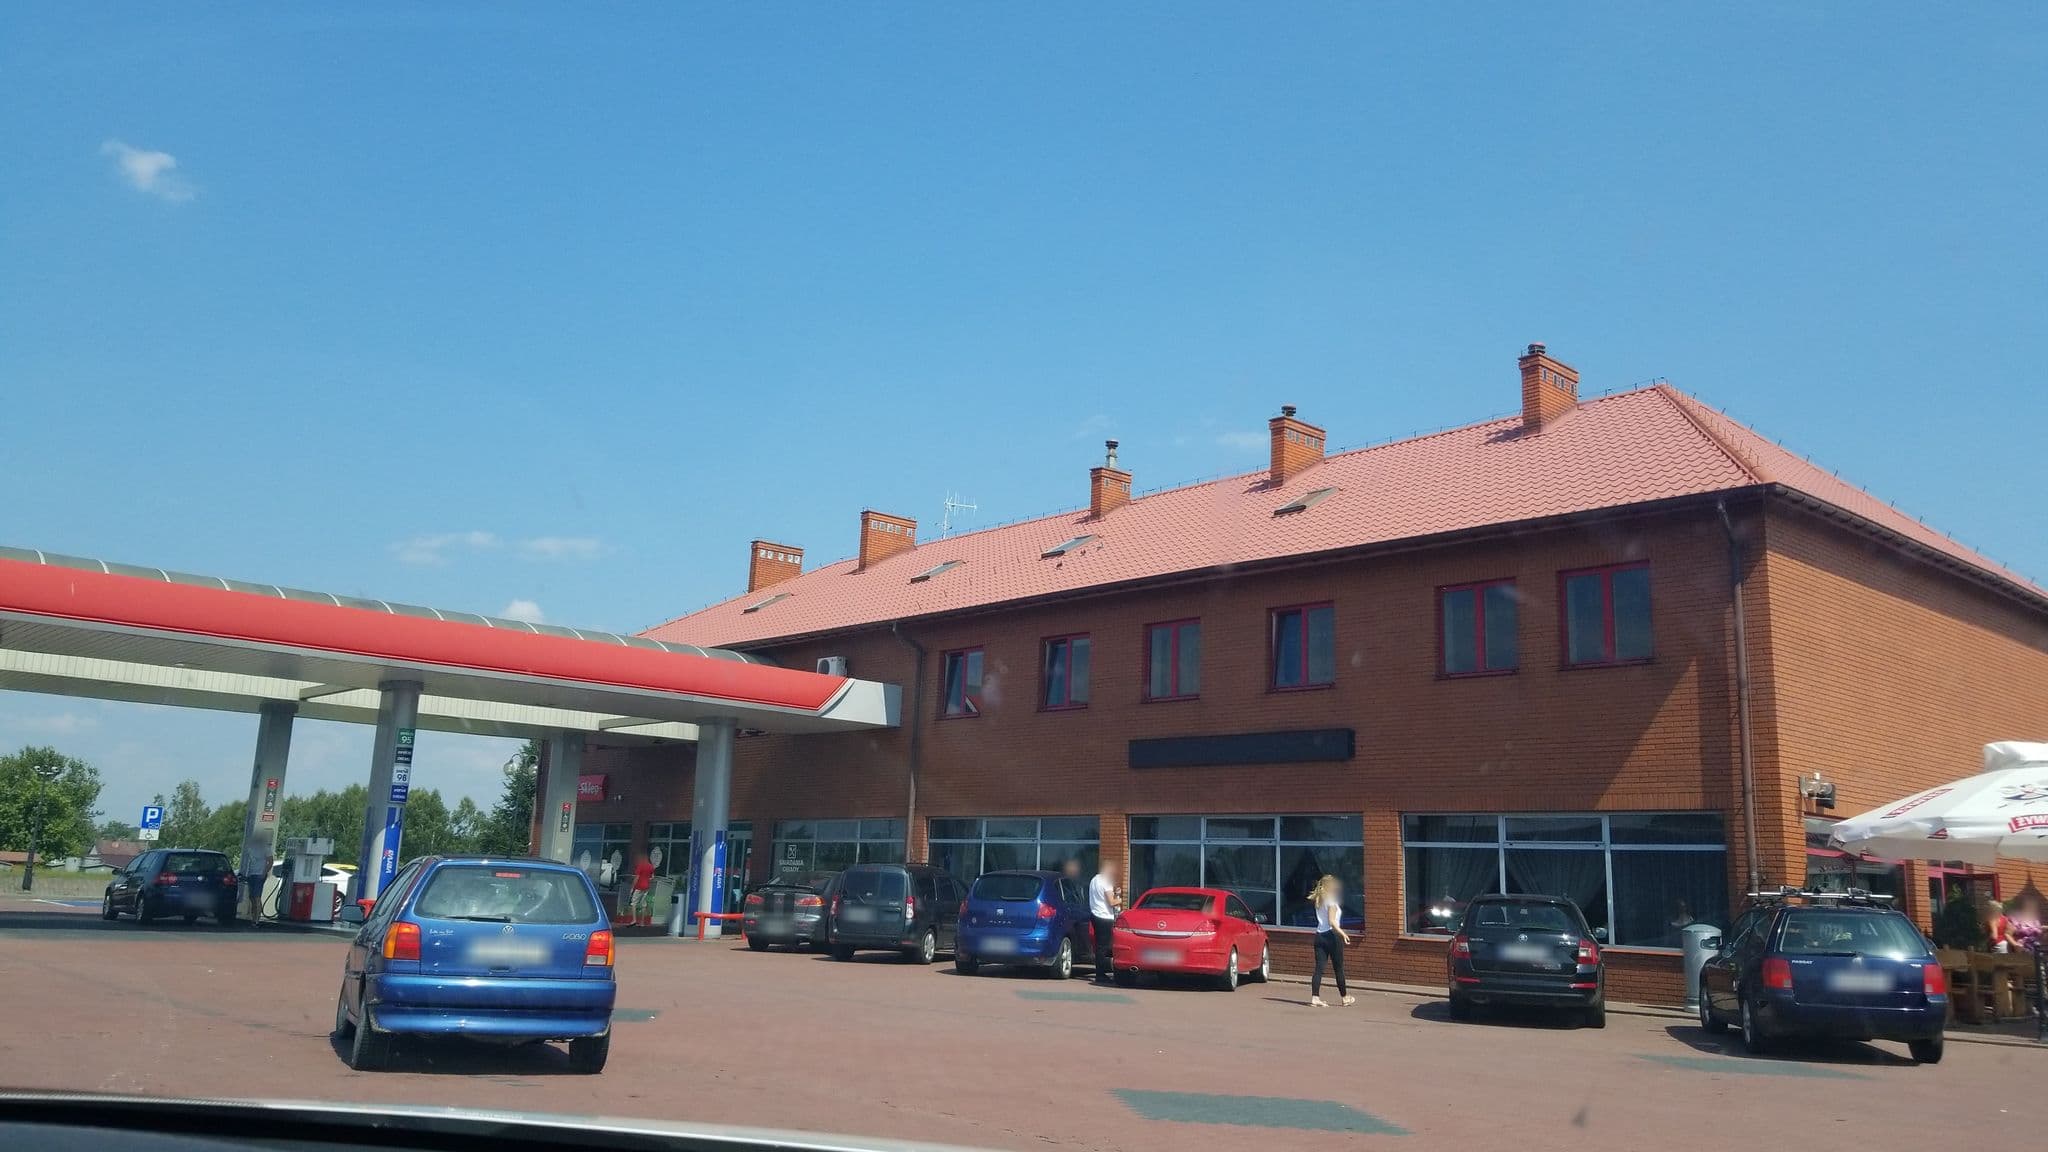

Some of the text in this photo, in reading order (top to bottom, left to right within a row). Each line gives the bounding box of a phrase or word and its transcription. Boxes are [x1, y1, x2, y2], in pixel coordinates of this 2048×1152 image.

[401, 735, 412, 745] 95
[396, 773, 408, 782] 98
[145, 807, 159, 823] P
